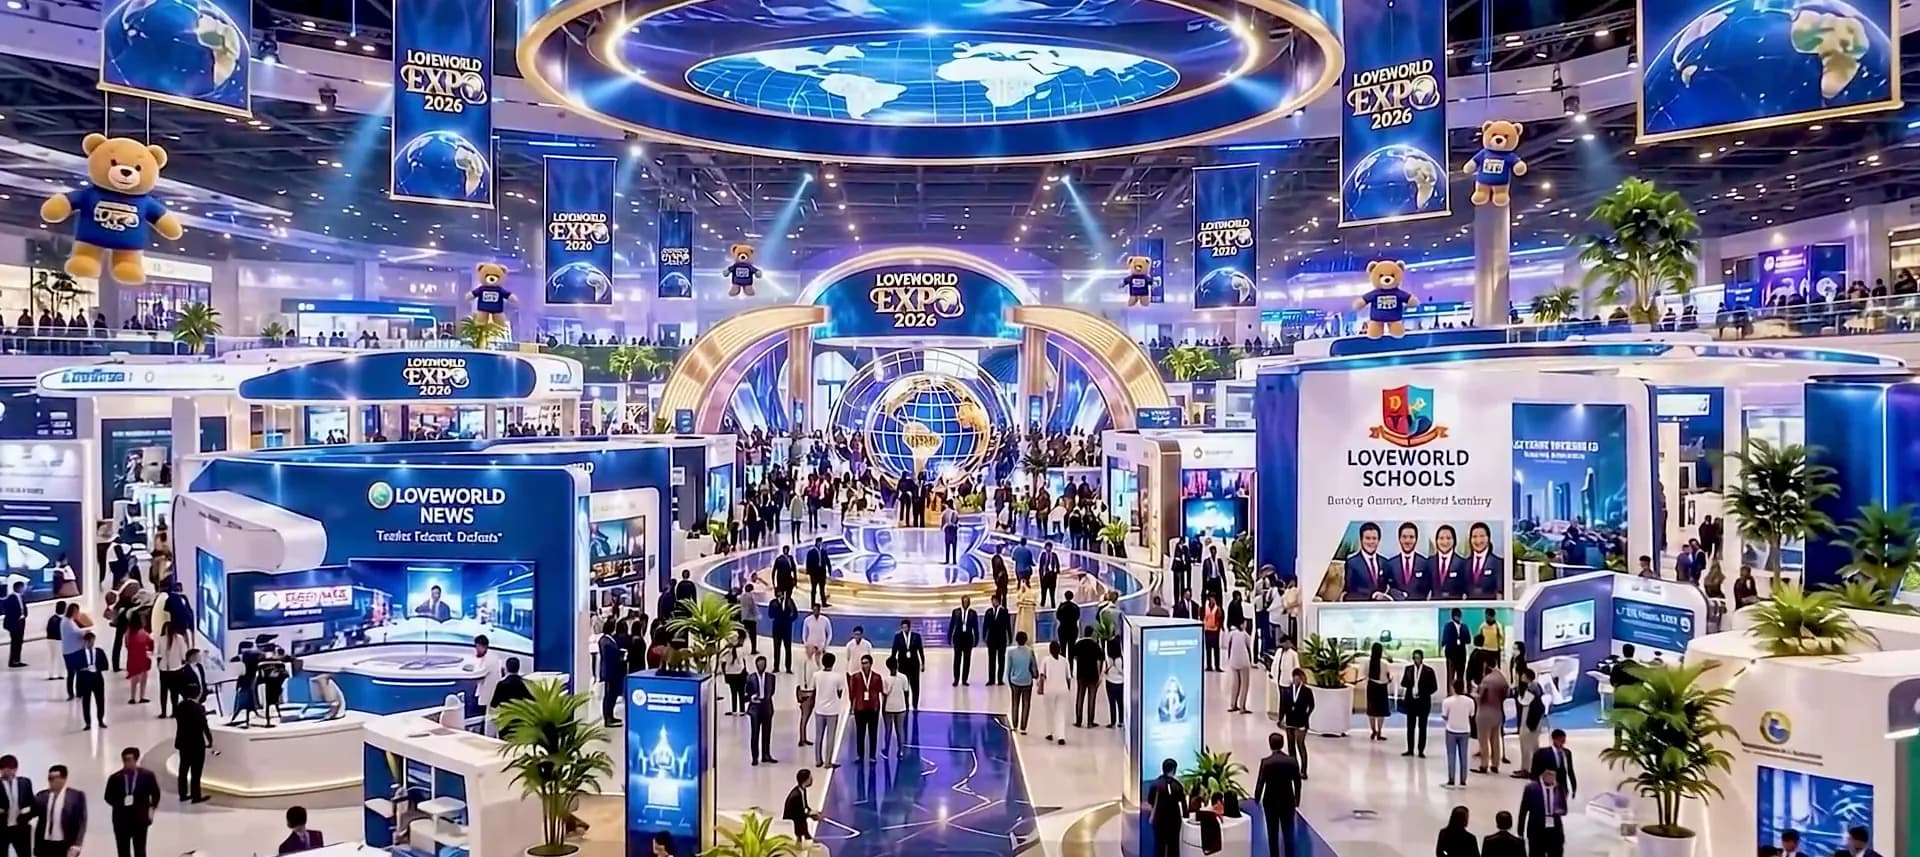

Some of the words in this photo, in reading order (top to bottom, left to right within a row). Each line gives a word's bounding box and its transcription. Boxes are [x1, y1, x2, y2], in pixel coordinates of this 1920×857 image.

[1353, 59, 1433, 88] LOVEWORLD
[400, 64, 488, 104] EXPO
[423, 94, 463, 113] 2026
[1346, 74, 1440, 116] EXPO
[1371, 107, 1413, 130] 2026
[548, 222, 610, 244] EXPO
[876, 273, 958, 287] LOVEWORLD
[869, 286, 965, 318] EXPO
[893, 312, 937, 328] 2026
[402, 367, 470, 388] EXPO
[419, 385, 452, 396] 2026
[1347, 449, 1470, 467] LOVEWORLD
[1362, 470, 1456, 487] SCHOOLS
[395, 487, 506, 505] LOVEWORLD
[420, 507, 475, 524] NEWS
